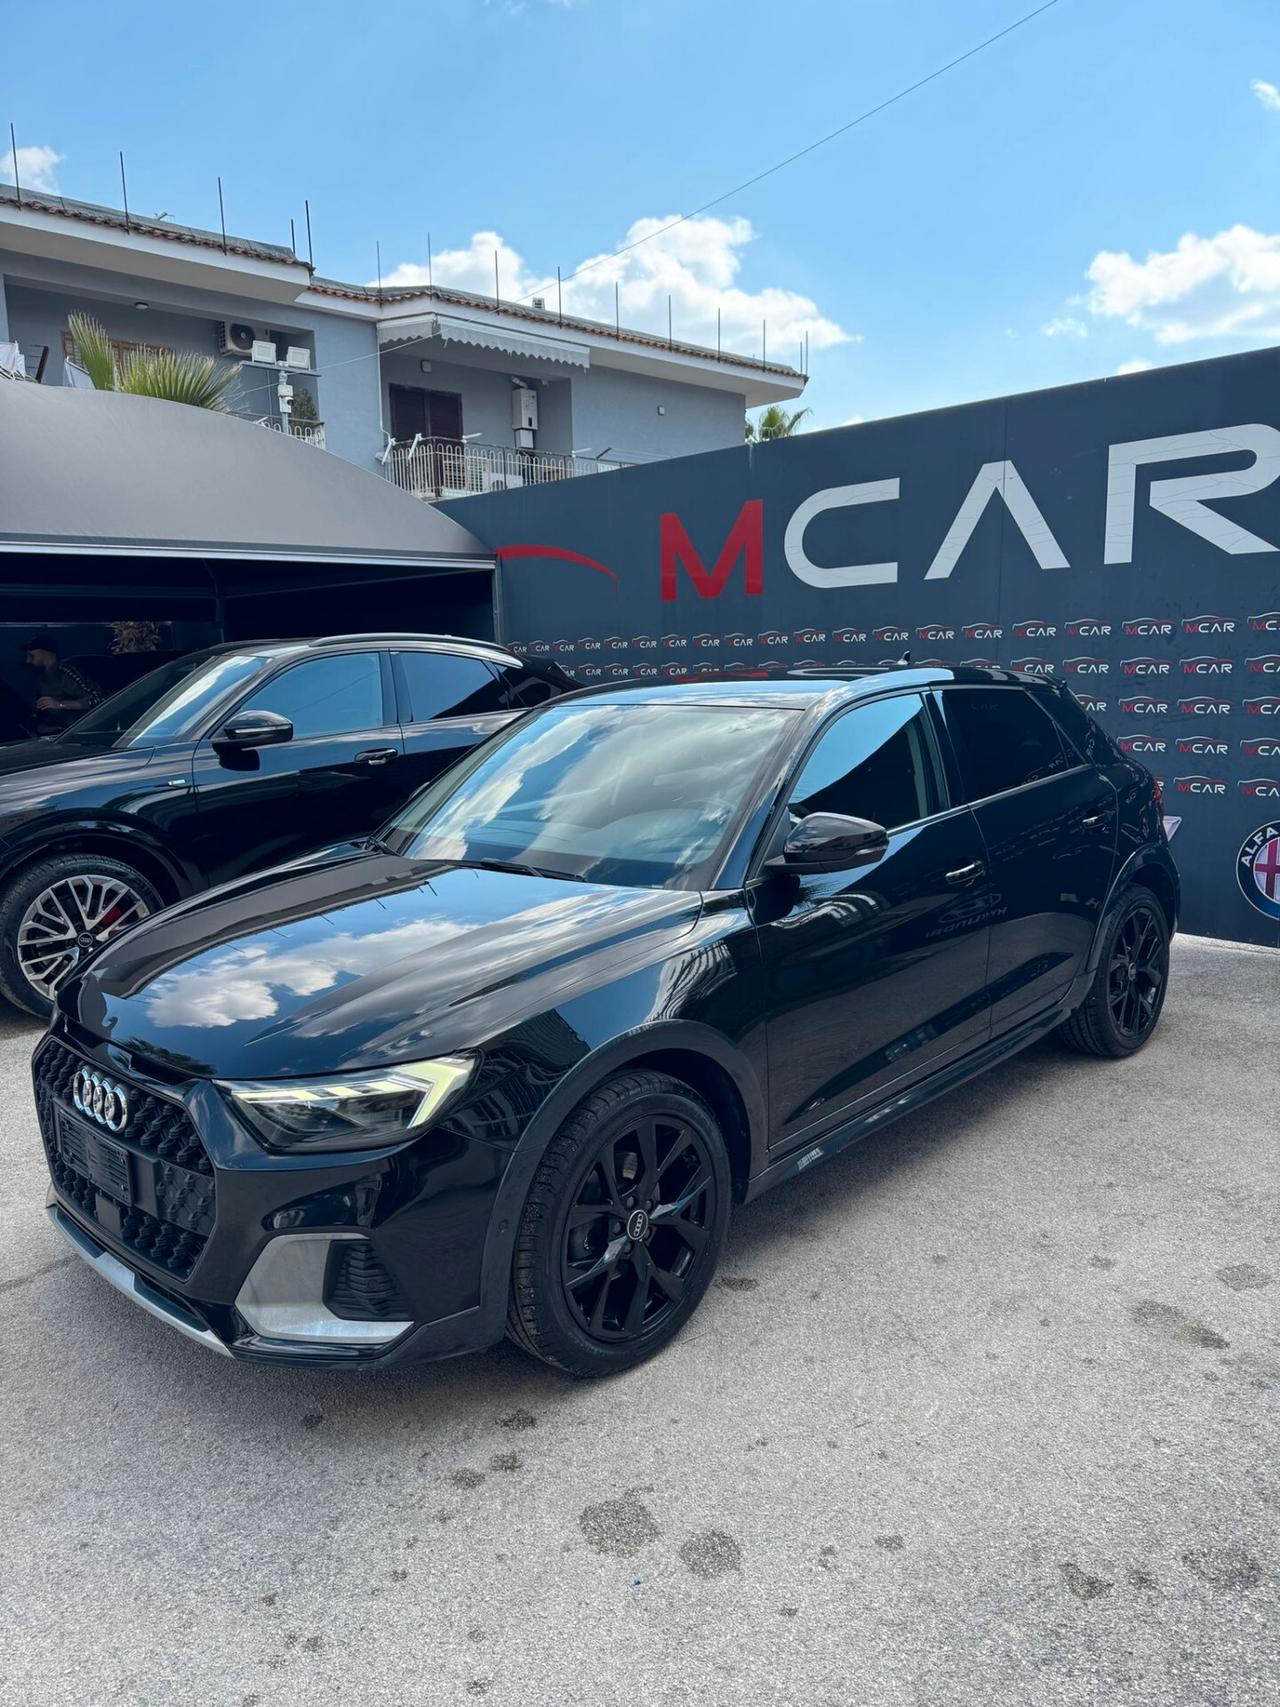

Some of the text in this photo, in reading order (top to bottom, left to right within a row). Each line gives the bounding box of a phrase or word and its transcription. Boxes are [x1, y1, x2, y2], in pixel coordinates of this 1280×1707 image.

[660, 423, 1280, 601] MCAR
[1125, 624, 1172, 636] MCAR
[1185, 622, 1235, 634] MCAR
[1252, 620, 1280, 632] MC
[1123, 664, 1170, 675] MCAR
[1183, 663, 1233, 674] MCAR
[1121, 703, 1168, 714] MCAR
[1181, 704, 1231, 714] MCAR
[1120, 742, 1166, 753] MCAR
[1178, 743, 1228, 755] MCAR
[1176, 783, 1226, 795] MCAR
[1241, 827, 1279, 867] ALFA
